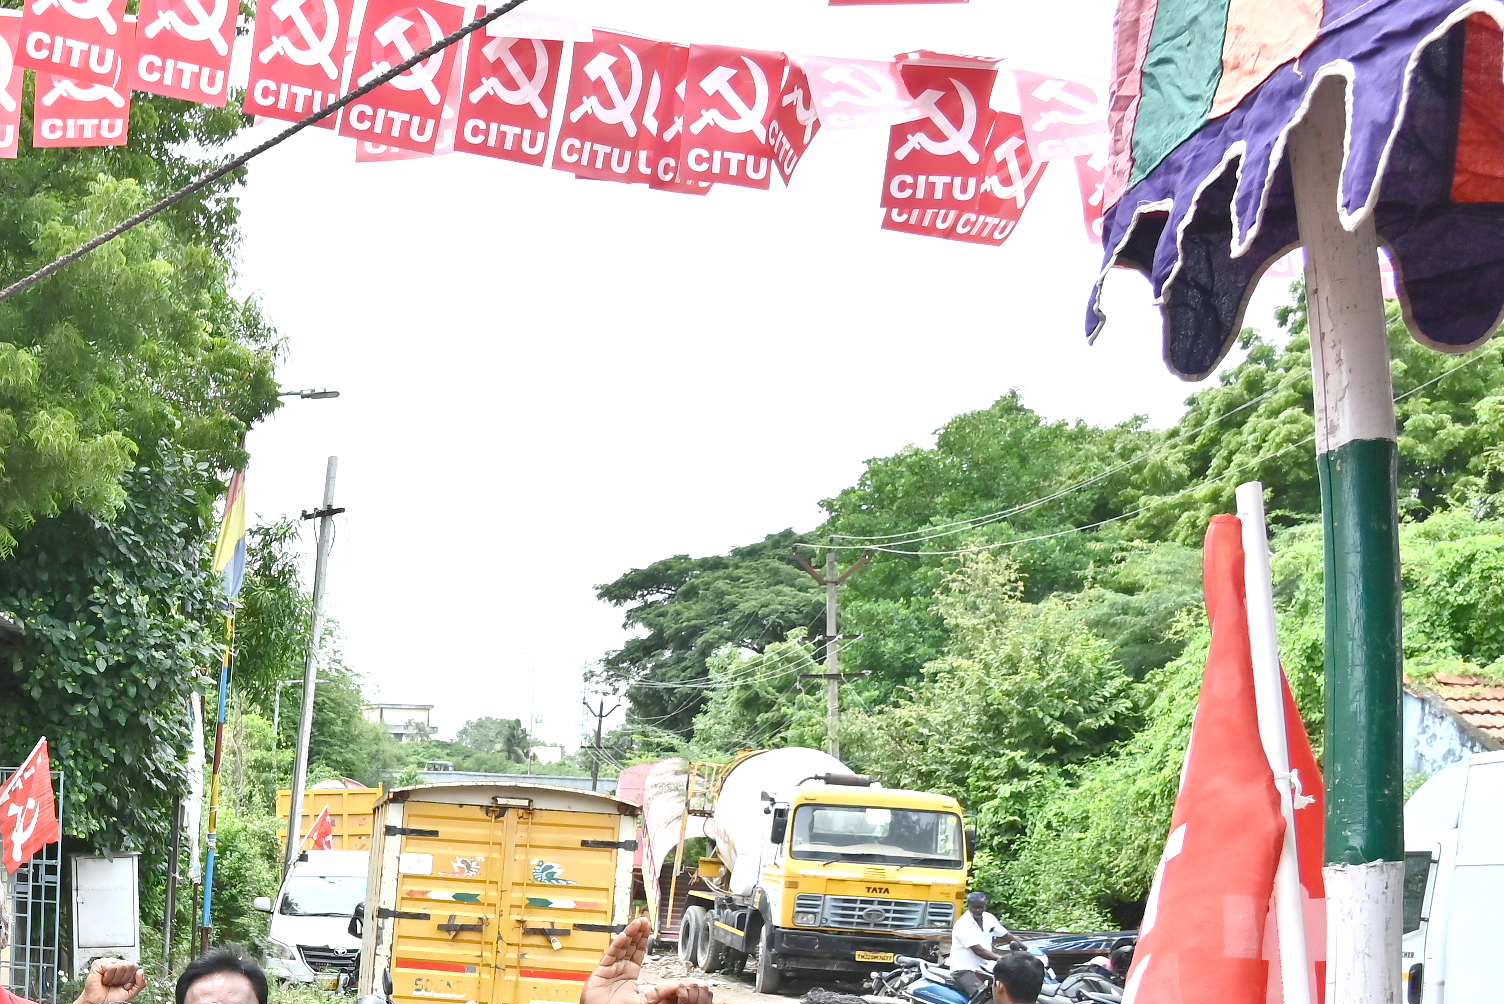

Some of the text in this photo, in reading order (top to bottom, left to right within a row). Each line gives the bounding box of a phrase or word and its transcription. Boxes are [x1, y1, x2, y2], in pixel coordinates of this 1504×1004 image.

[25, 31, 115, 75] CITU
[138, 54, 225, 96] CITU
[40, 118, 124, 139] CITU
[348, 104, 436, 143] CITU
[463, 119, 545, 156] CITU
[560, 137, 630, 173] CITU
[687, 148, 768, 180] CITU
[768, 121, 797, 176] CITU
[890, 175, 976, 200] CITU
[955, 211, 1015, 240] CITU
[866, 886, 890, 895] TATA
